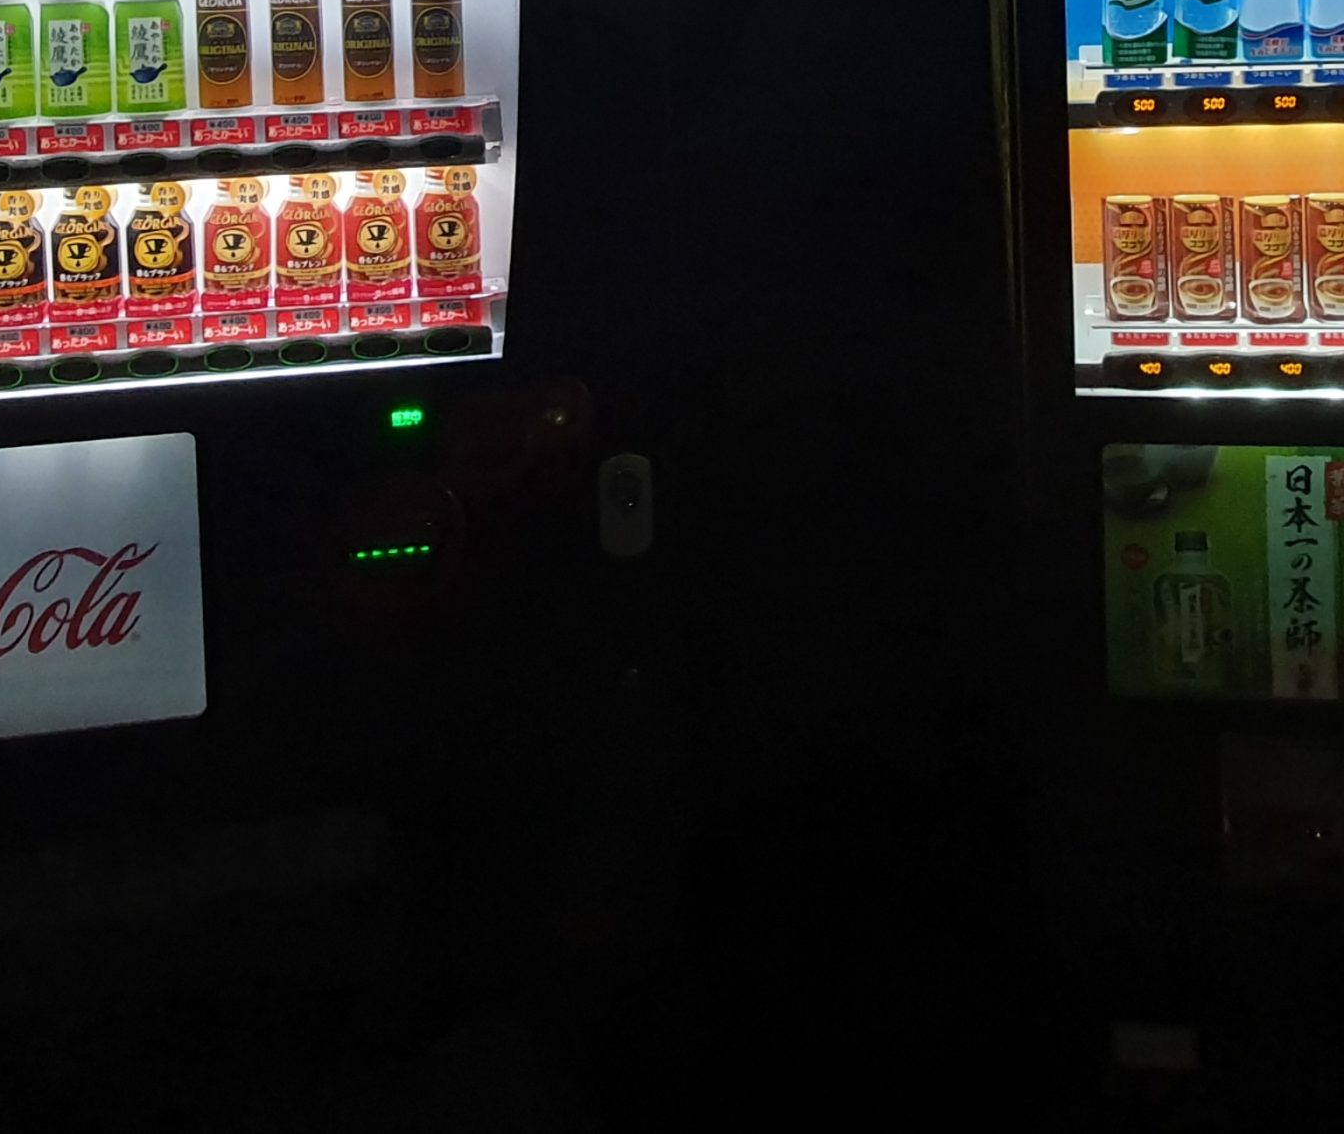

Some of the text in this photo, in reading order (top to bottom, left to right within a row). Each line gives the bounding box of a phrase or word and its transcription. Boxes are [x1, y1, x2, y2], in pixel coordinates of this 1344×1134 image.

[1133, 99, 1155, 112] 500
[1203, 97, 1225, 110] 500
[1274, 95, 1297, 109] 500
[1283, 464, 1322, 656] 日本一の茶師
